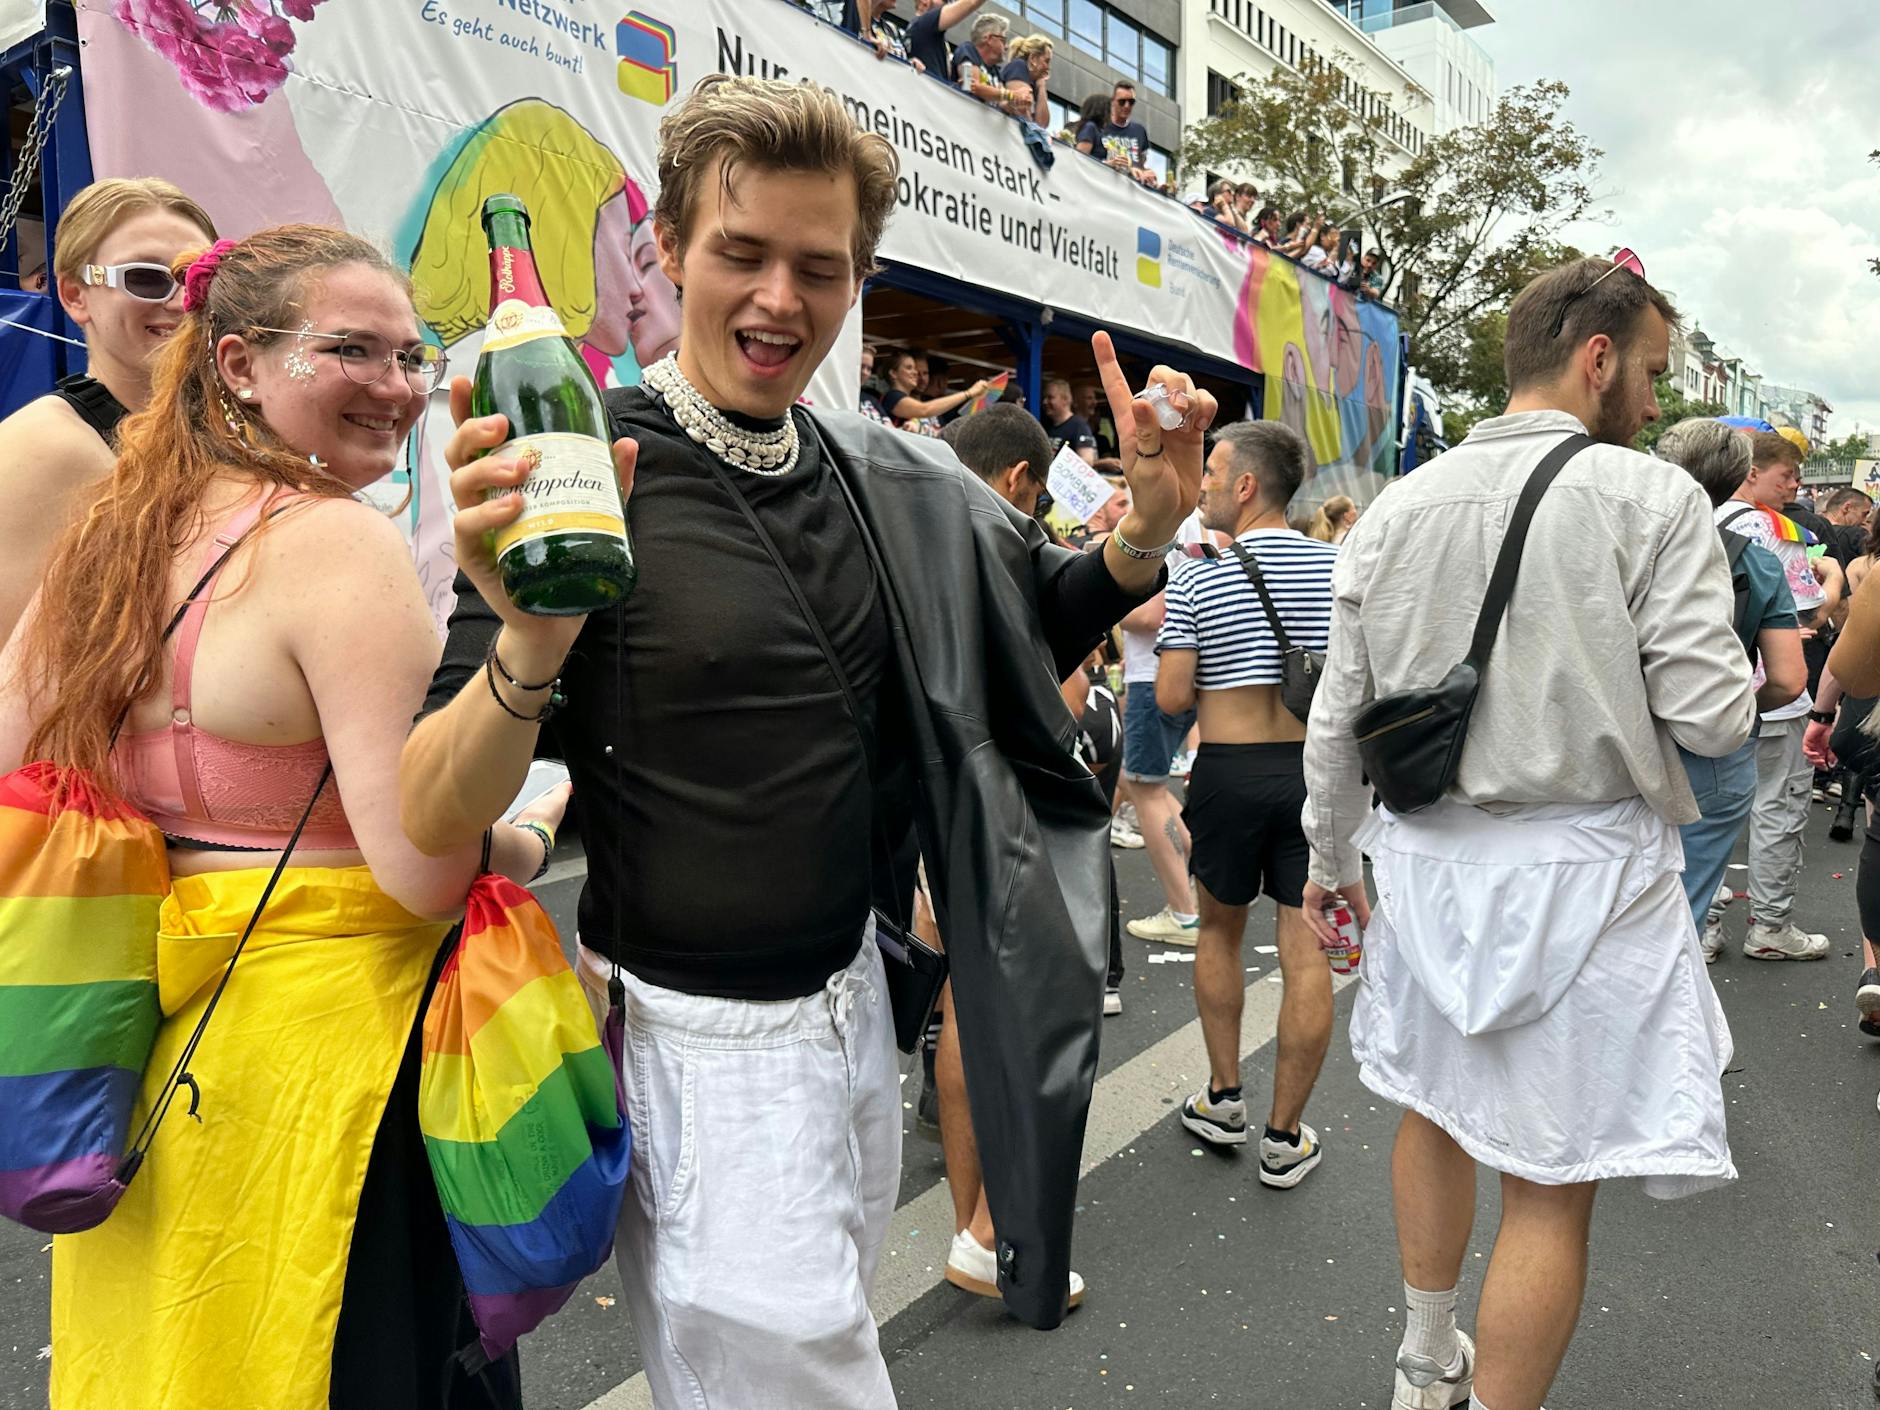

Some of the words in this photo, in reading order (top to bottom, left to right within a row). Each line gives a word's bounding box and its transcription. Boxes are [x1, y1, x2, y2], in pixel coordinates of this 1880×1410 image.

[421, 0, 447, 25] Es
[453, 17, 493, 41] geht
[500, 33, 539, 57] auch
[546, 42, 583, 74] bunt!
[498, 0, 606, 51] etzwerk
[801, 77, 976, 176] meinsam
[981, 154, 1044, 205] stark
[897, 171, 992, 236] okratie
[1001, 213, 1042, 254] und
[1049, 221, 1119, 281] Vielfalt
[1053, 462, 1098, 504] BOMBING
[1063, 451, 1096, 479] STOP
[1051, 478, 1093, 518] HILDREN
